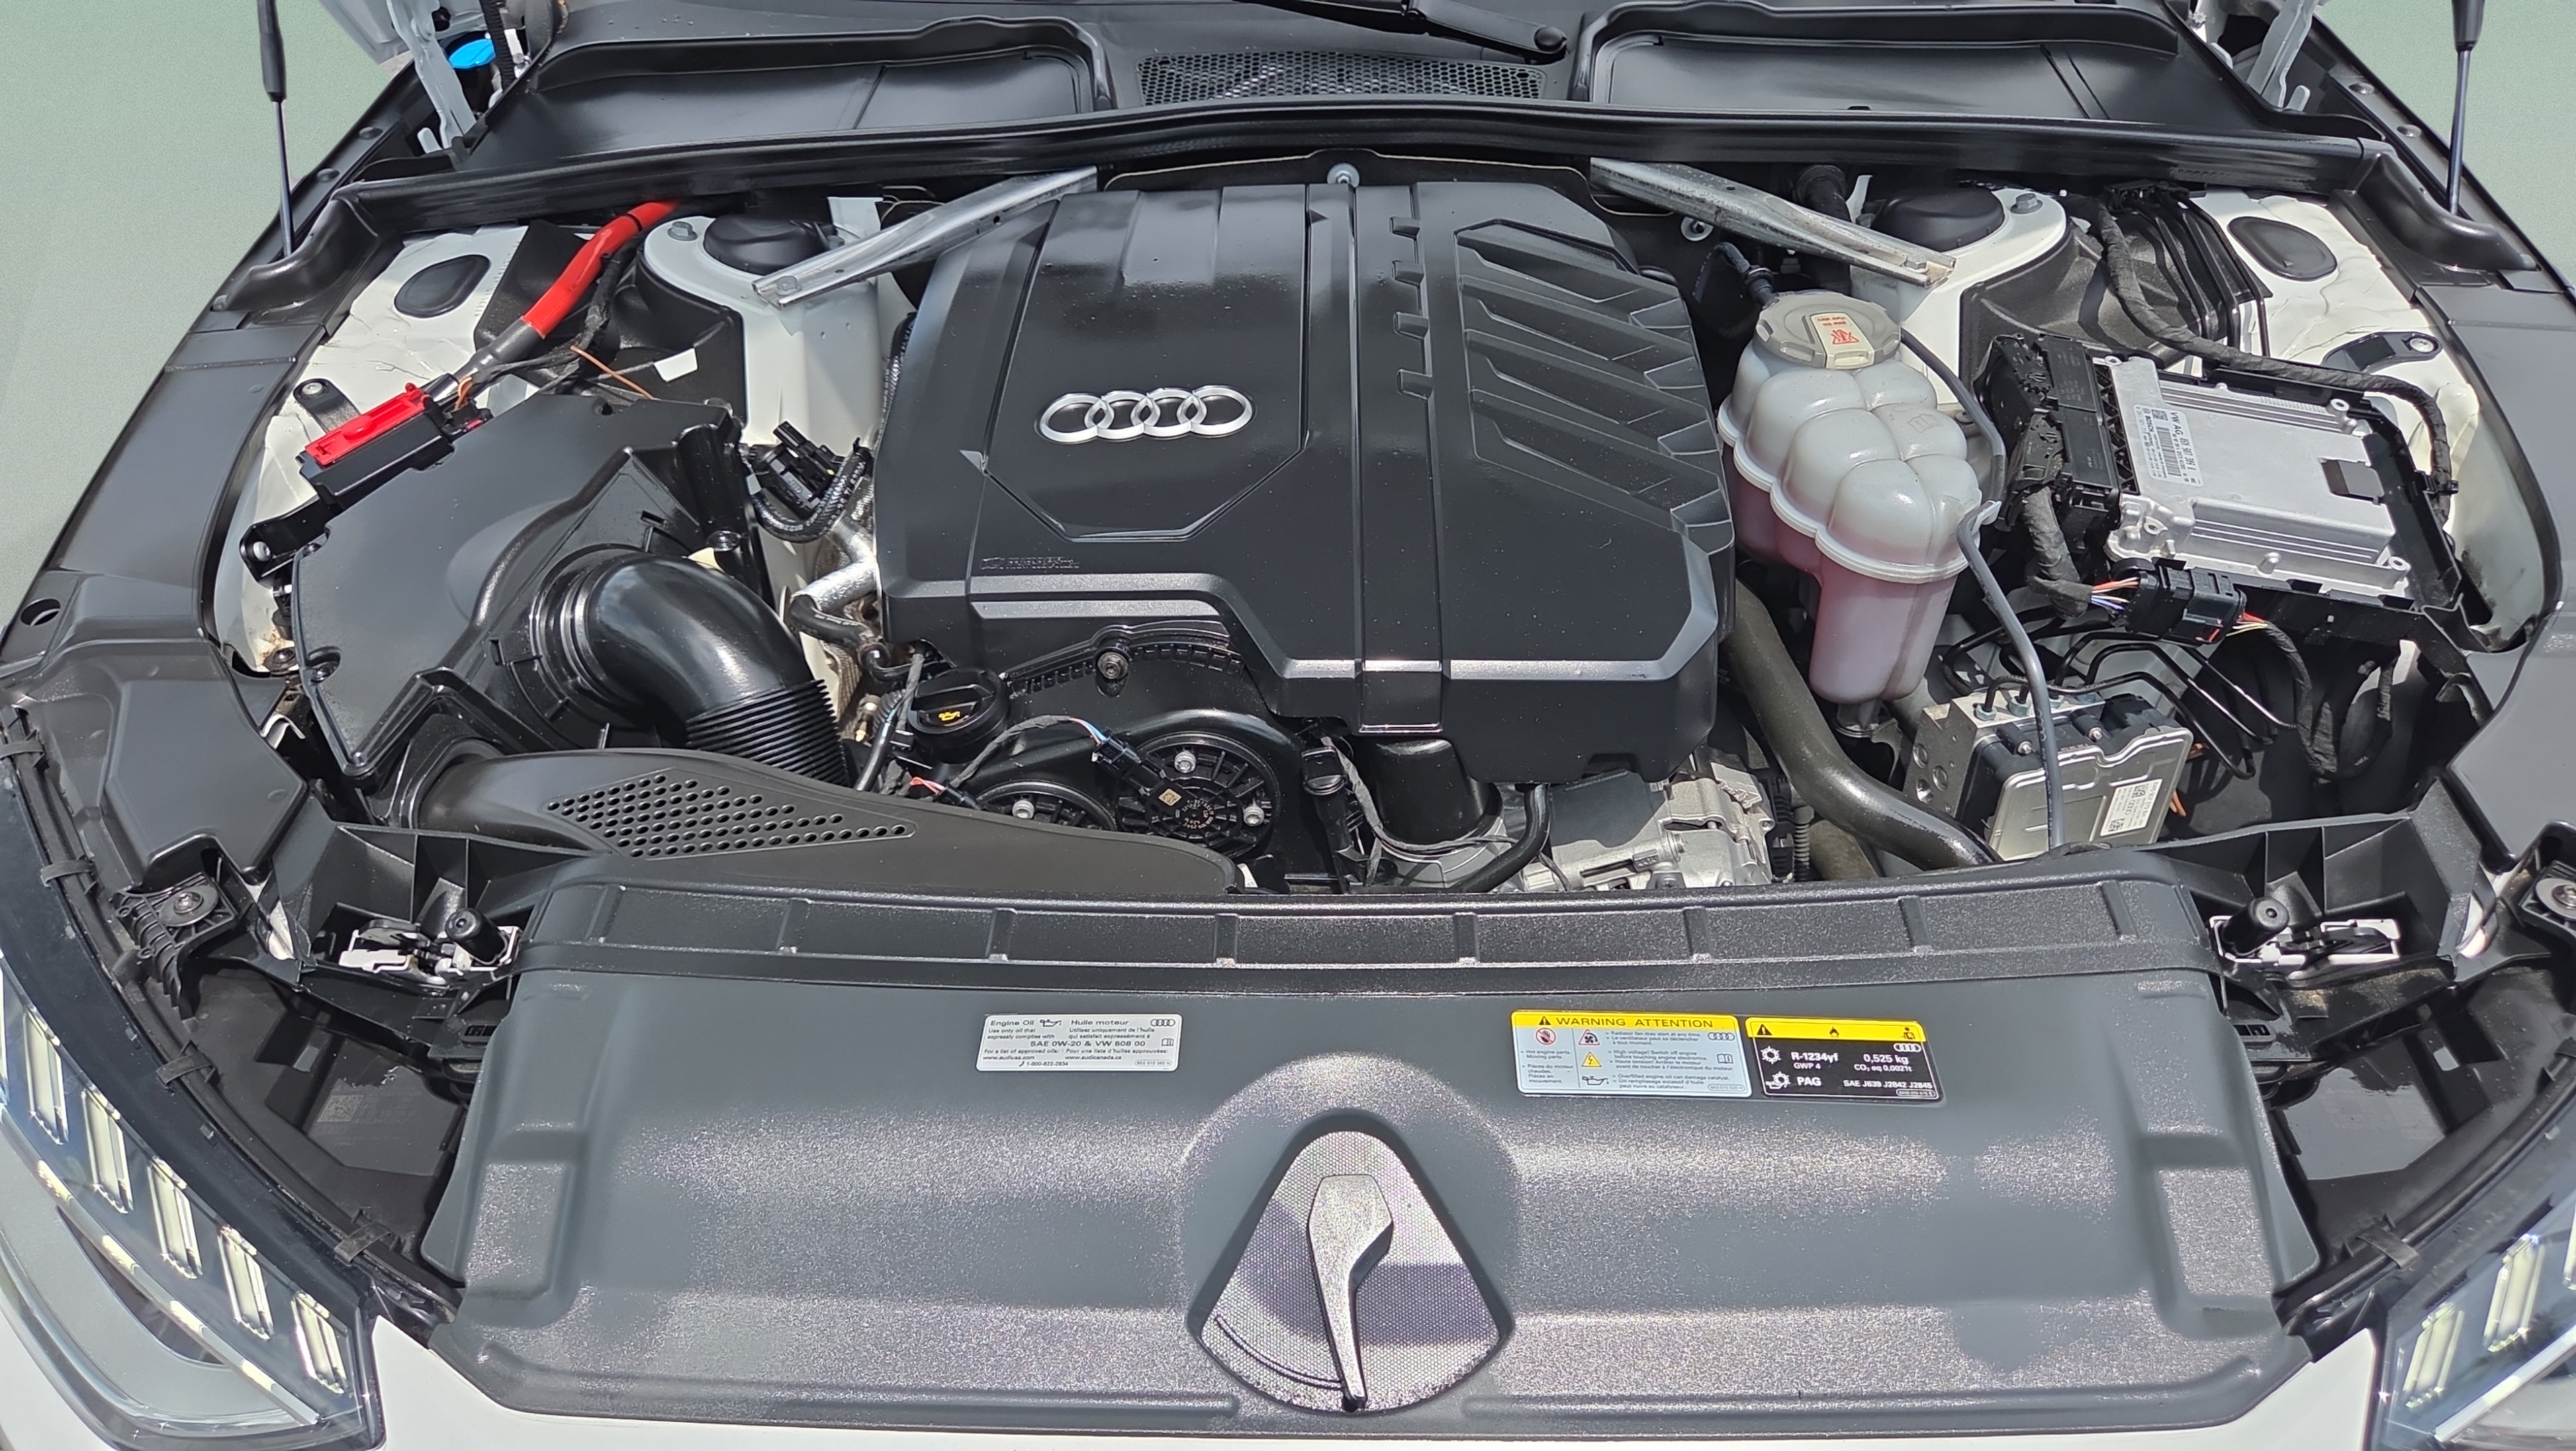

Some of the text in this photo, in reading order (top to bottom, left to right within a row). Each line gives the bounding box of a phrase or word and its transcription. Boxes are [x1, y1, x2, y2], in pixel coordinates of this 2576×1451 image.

[2170, 412, 2180, 424] VW
[2145, 415, 2154, 433] BOSCH
[2173, 425, 2183, 435] AG
[1555, 1017, 1713, 1028] WARNING ATTENTION
[1791, 1052, 1839, 1063] R-1234yf
[1864, 1054, 1908, 1065] 0,525 kg
[1796, 1076, 1822, 1086] PAG
